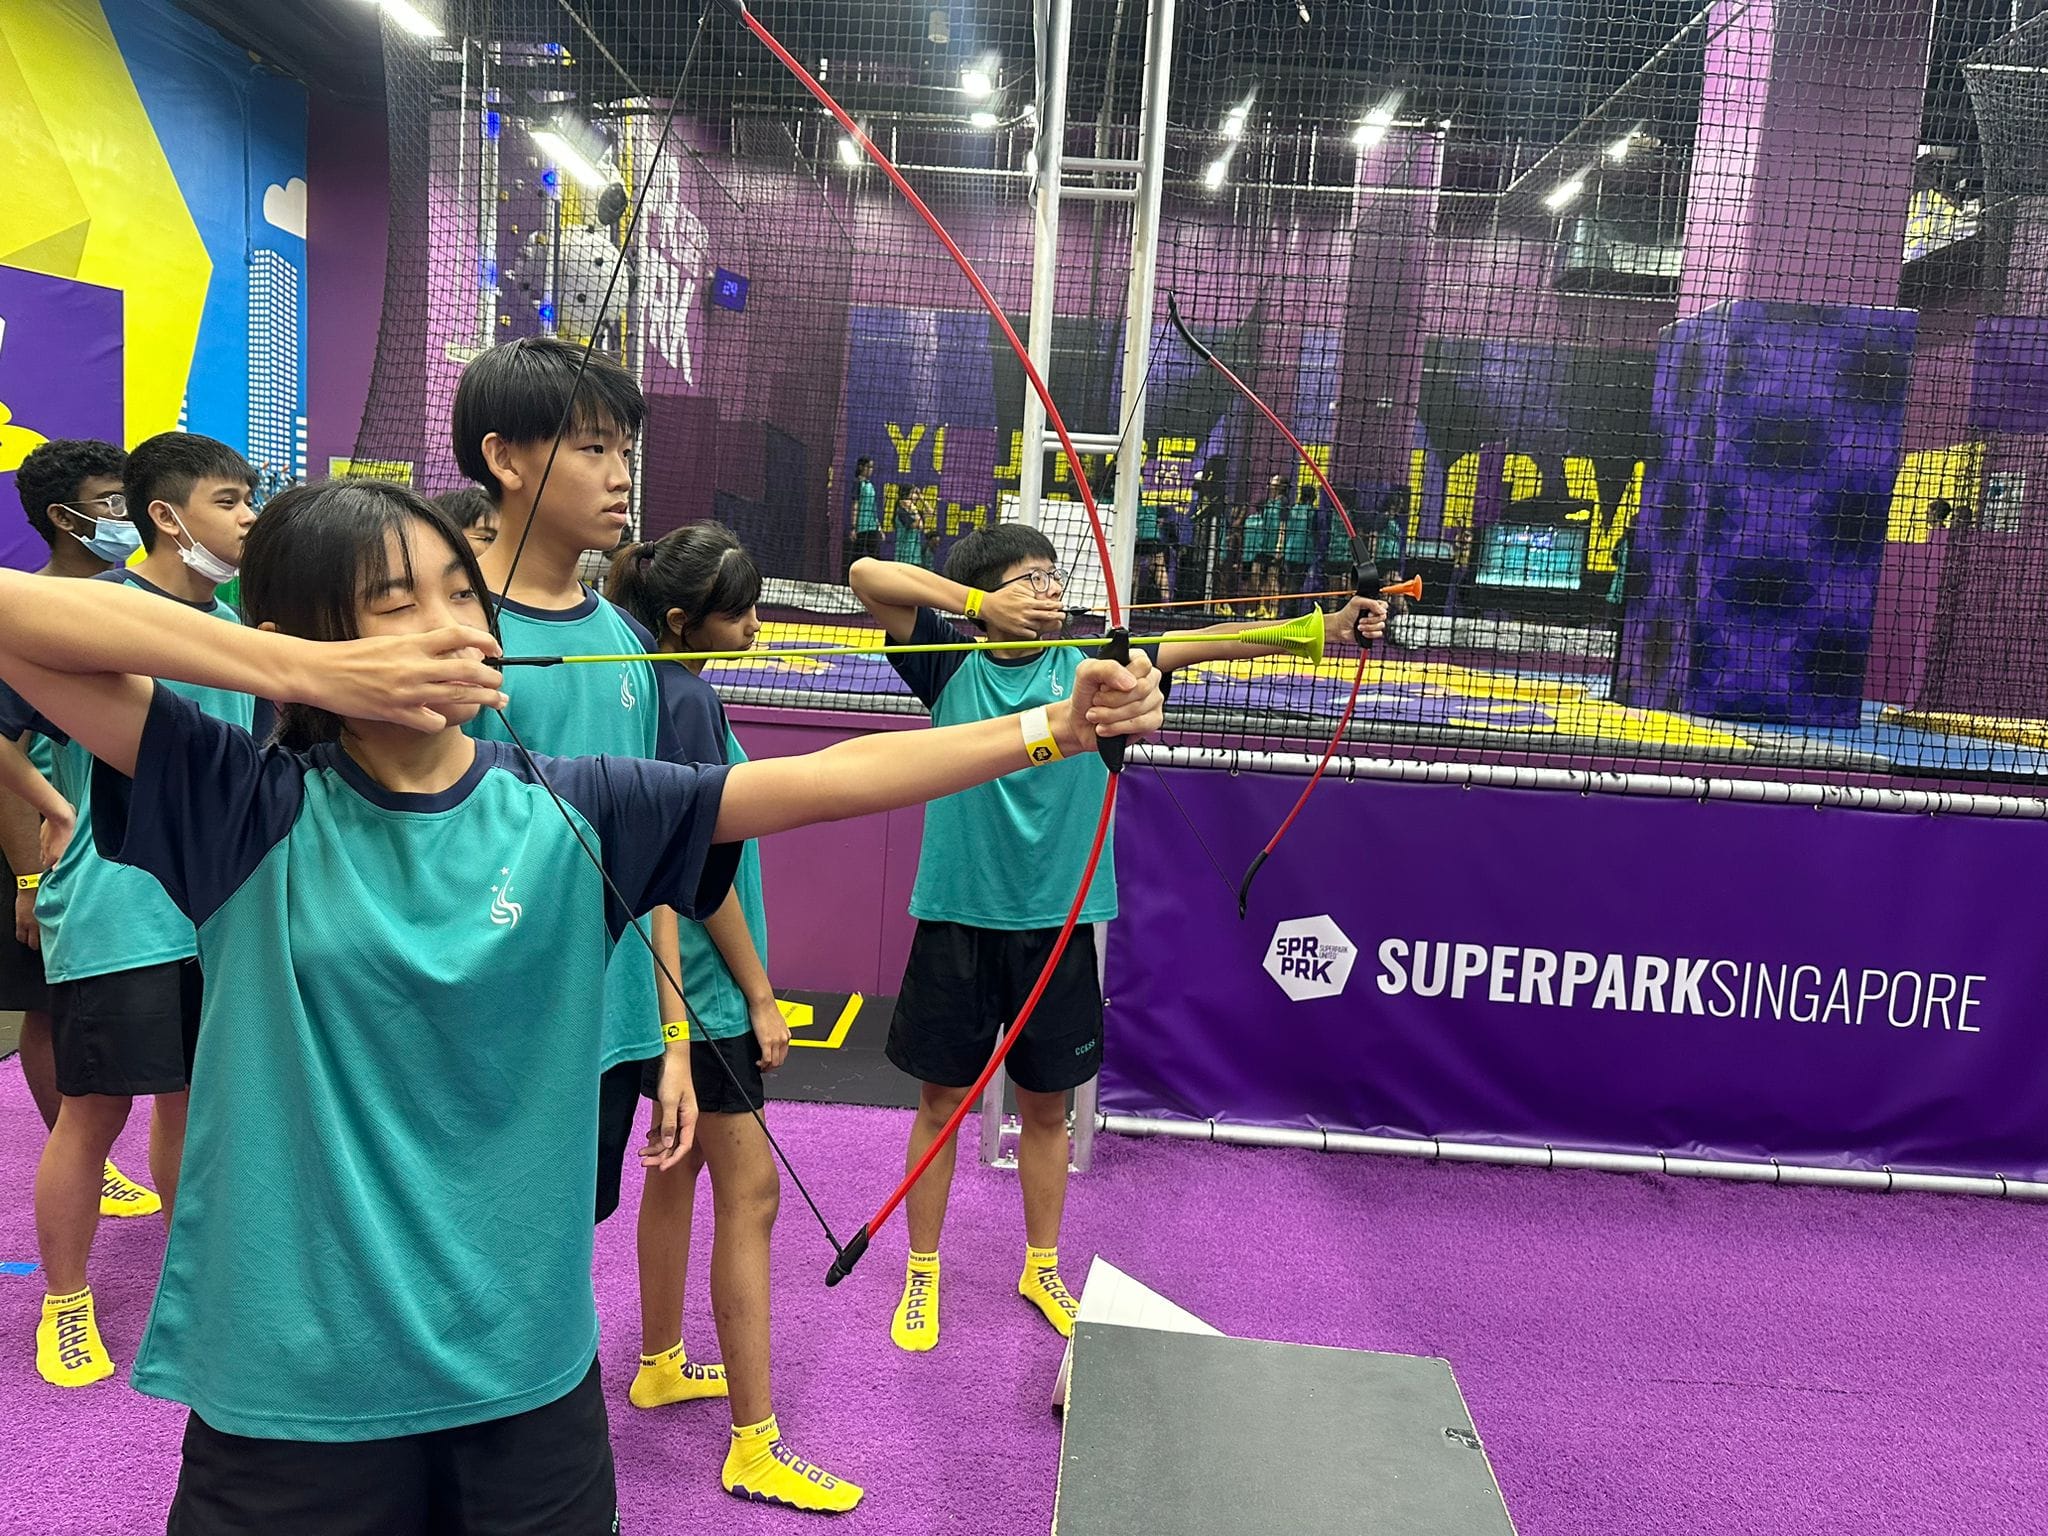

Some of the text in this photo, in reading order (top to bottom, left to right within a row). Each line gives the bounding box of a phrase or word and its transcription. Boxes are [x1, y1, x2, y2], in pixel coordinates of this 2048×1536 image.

[1276, 936, 1318, 958] SPR
[1281, 957, 1333, 984] PRK
[57, 1304, 93, 1371] SPRPRK
